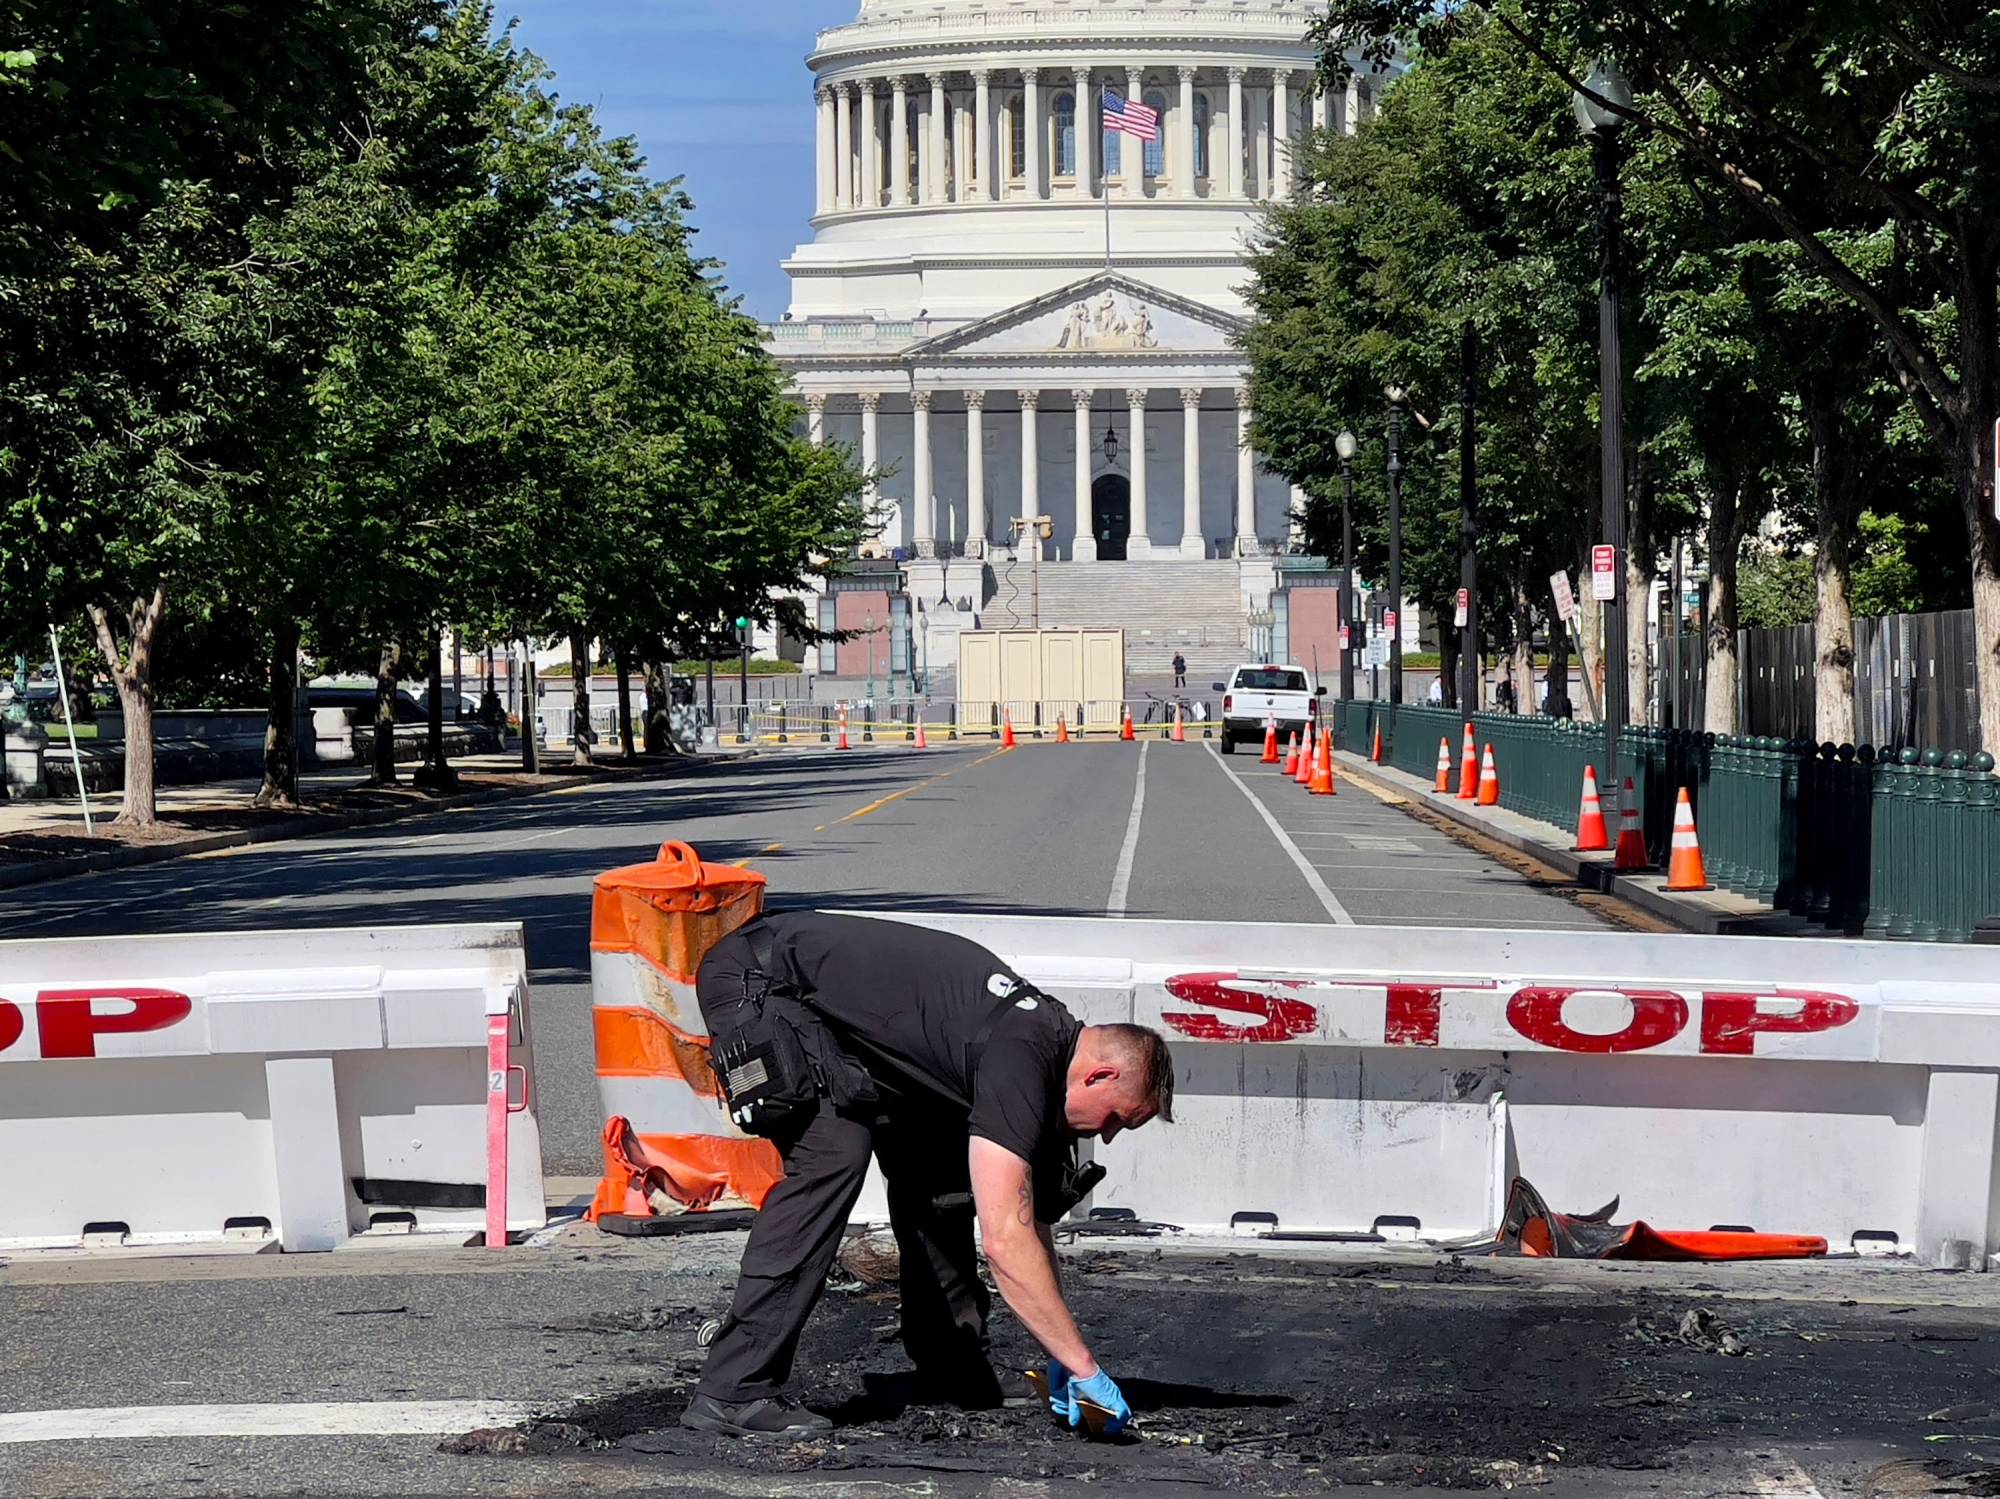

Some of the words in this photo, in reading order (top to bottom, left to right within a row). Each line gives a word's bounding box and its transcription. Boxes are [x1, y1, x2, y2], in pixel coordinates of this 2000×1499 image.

[0, 987, 192, 1059] P
[1161, 972, 1859, 1054] STOP
[491, 1071, 503, 1091] 2
